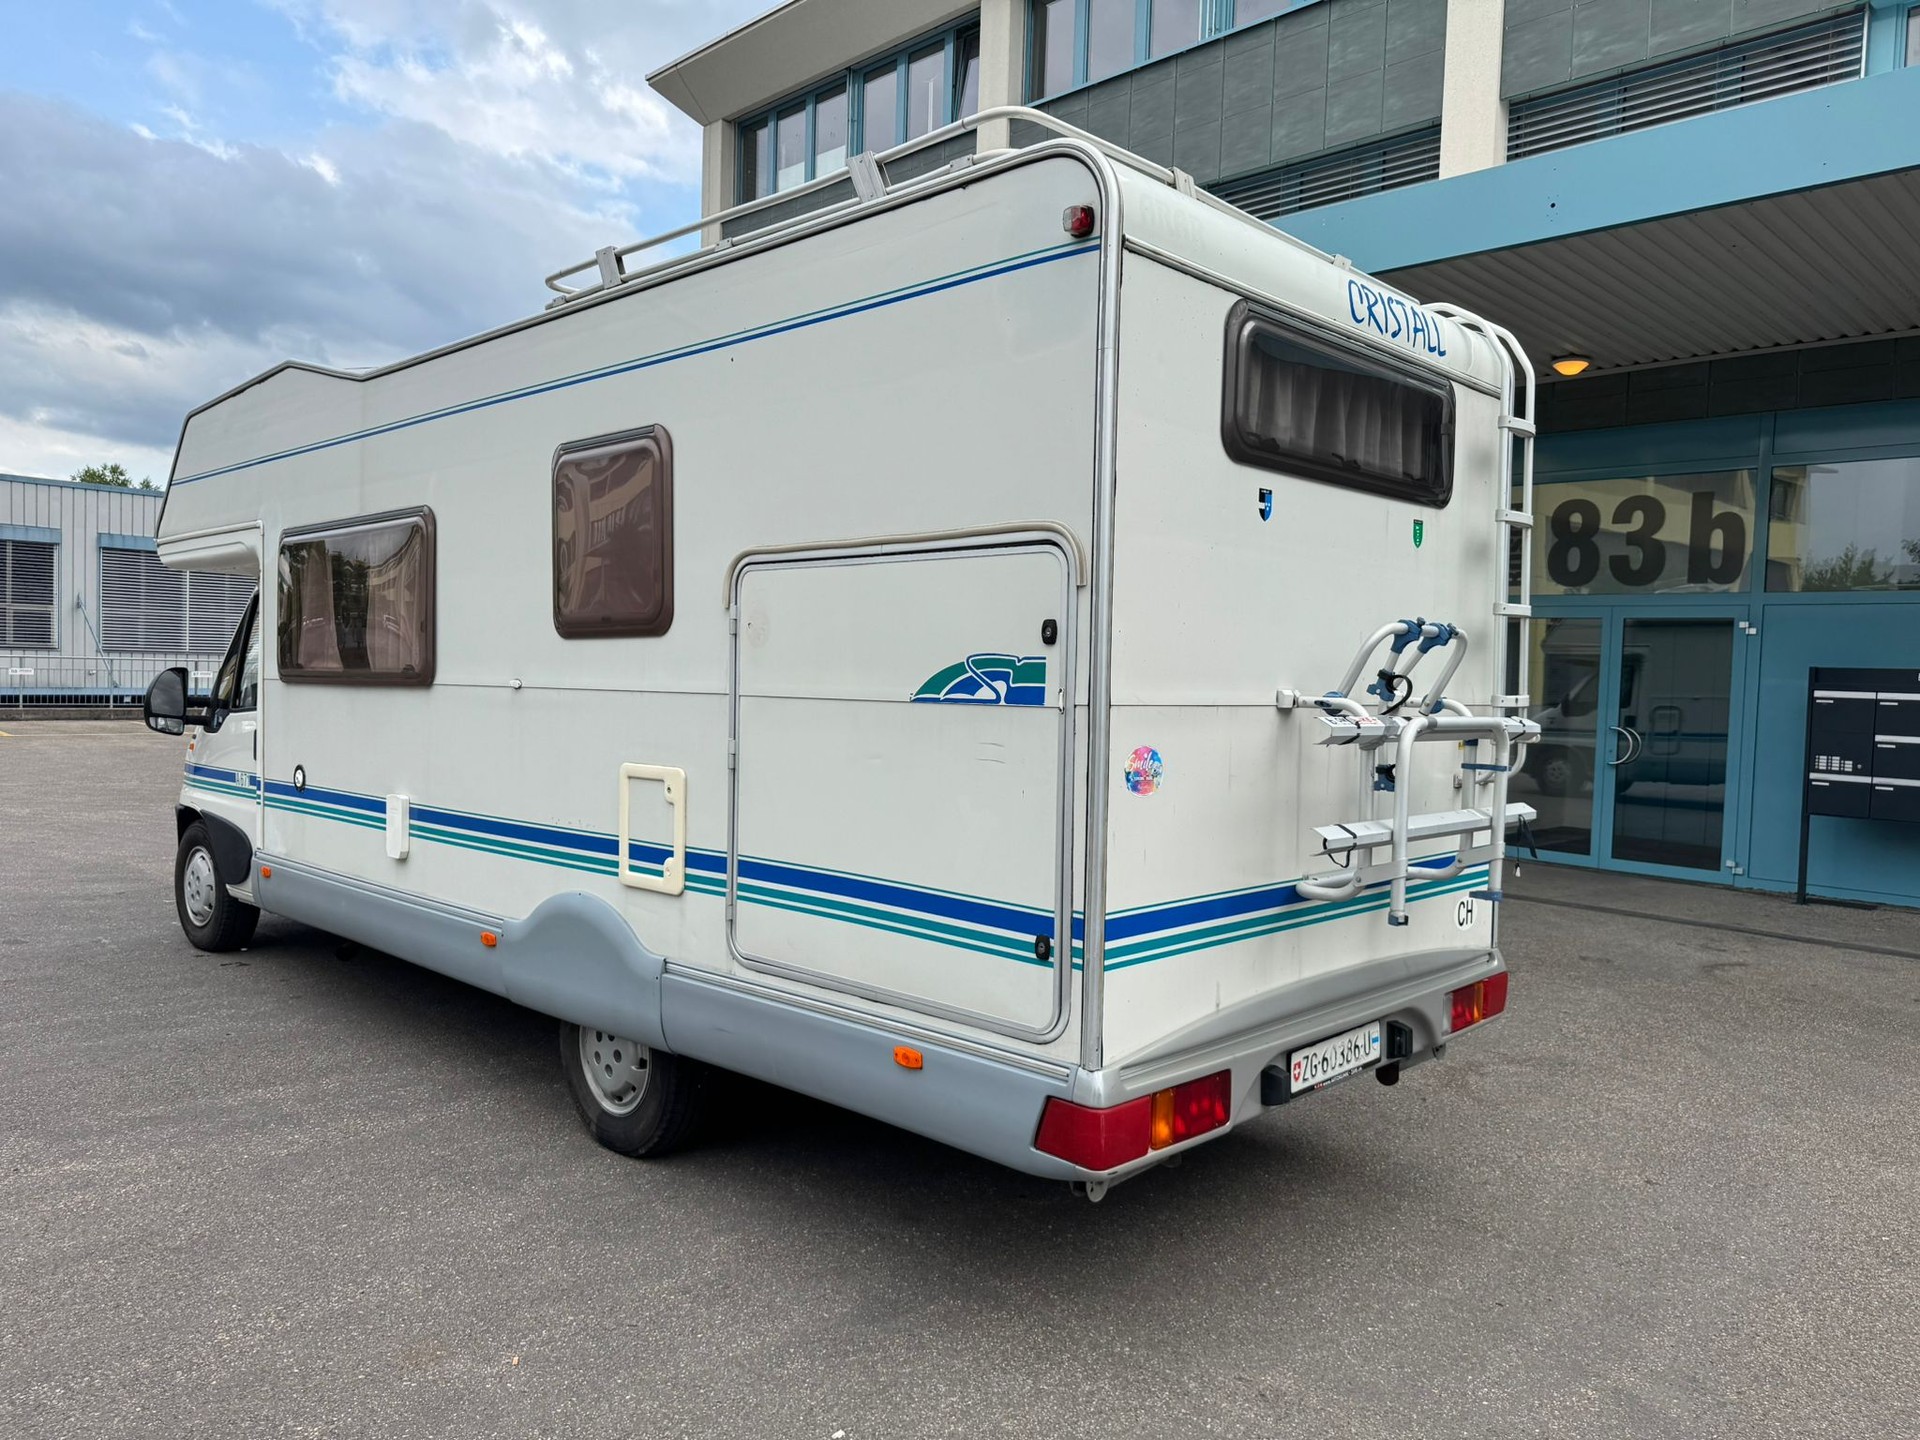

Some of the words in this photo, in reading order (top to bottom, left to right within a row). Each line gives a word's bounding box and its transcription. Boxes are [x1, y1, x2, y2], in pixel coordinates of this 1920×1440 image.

[1348, 279, 1446, 356] CRISTALL
[1547, 495, 1667, 587] 83
[1687, 491, 1746, 585] b
[1457, 899, 1474, 927] CH
